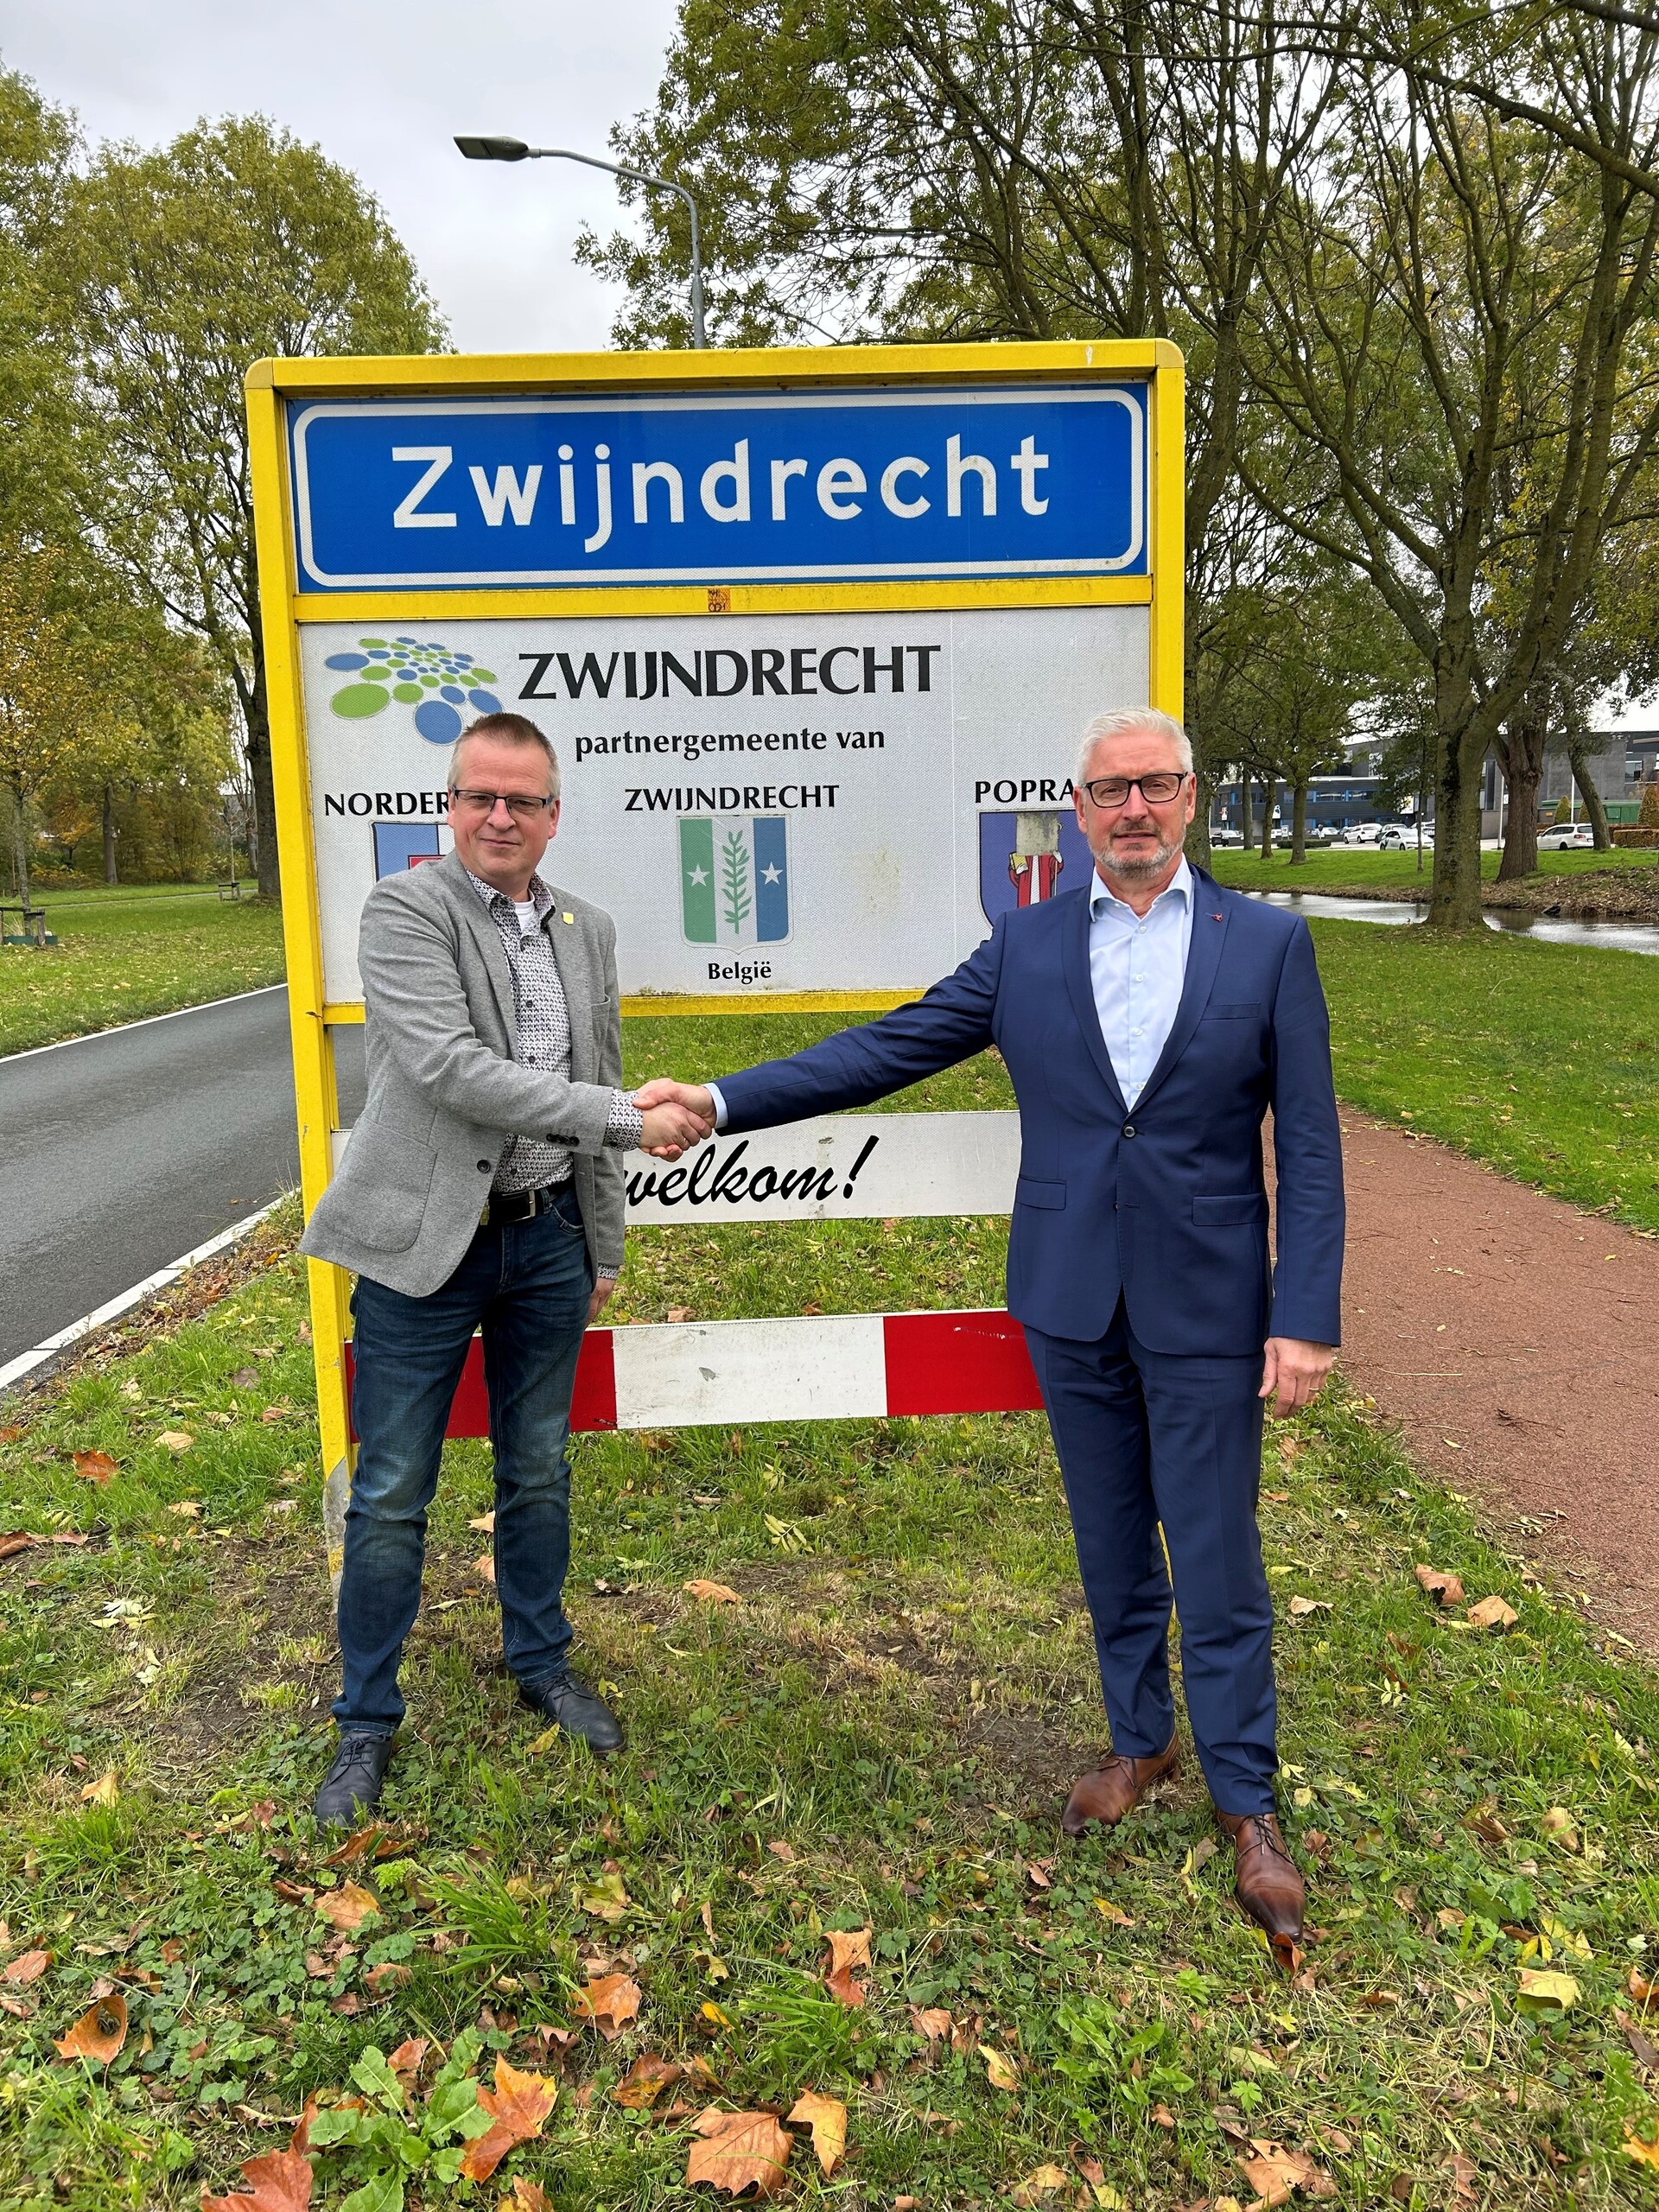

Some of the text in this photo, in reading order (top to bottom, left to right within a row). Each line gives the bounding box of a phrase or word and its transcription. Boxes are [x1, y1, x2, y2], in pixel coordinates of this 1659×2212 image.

[391, 434, 1051, 553] Zwijndrecht
[518, 645, 941, 701] ZWIJNDRECHT
[575, 728, 885, 762] partnergemeente van
[325, 791, 448, 816] NORDER
[625, 785, 840, 811] ZWIJNDRECHT
[975, 779, 1074, 804] POPRA
[708, 962, 772, 983] België
[624, 1135, 880, 1206] welkom!
